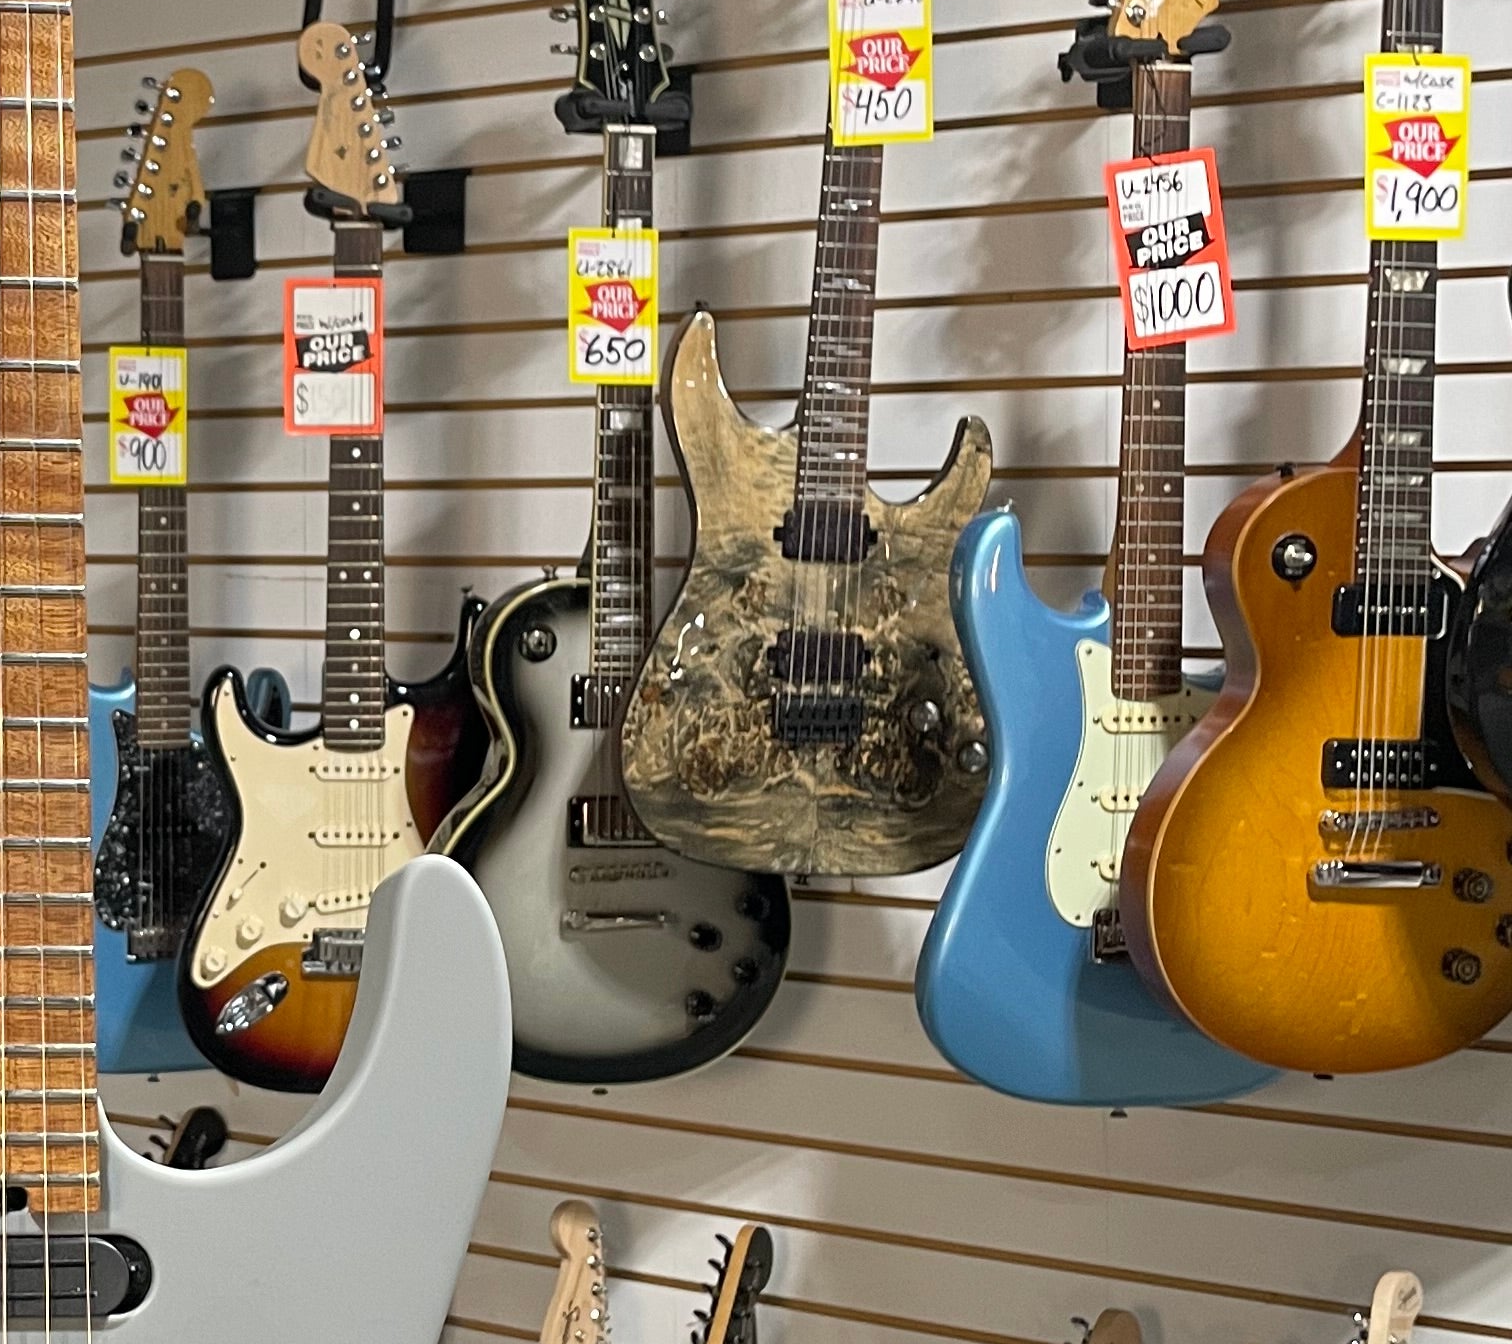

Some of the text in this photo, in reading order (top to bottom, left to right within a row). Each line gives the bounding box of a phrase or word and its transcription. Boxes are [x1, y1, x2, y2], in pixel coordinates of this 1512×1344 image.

[862, 37, 903, 56] OUR
[857, 54, 910, 74] PRICE
[1398, 122, 1440, 142] OUR
[1392, 140, 1448, 162] PRICE
[1141, 217, 1190, 247] OUR
[1136, 230, 1204, 267] PRICE
[597, 285, 633, 303] OUR
[1134, 271, 1216, 331] $1000
[592, 301, 639, 319] PRICE
[309, 333, 354, 352] OUR
[302, 344, 365, 368] PRICE
[133, 397, 165, 413] OUR
[129, 411, 171, 427] PRICE
